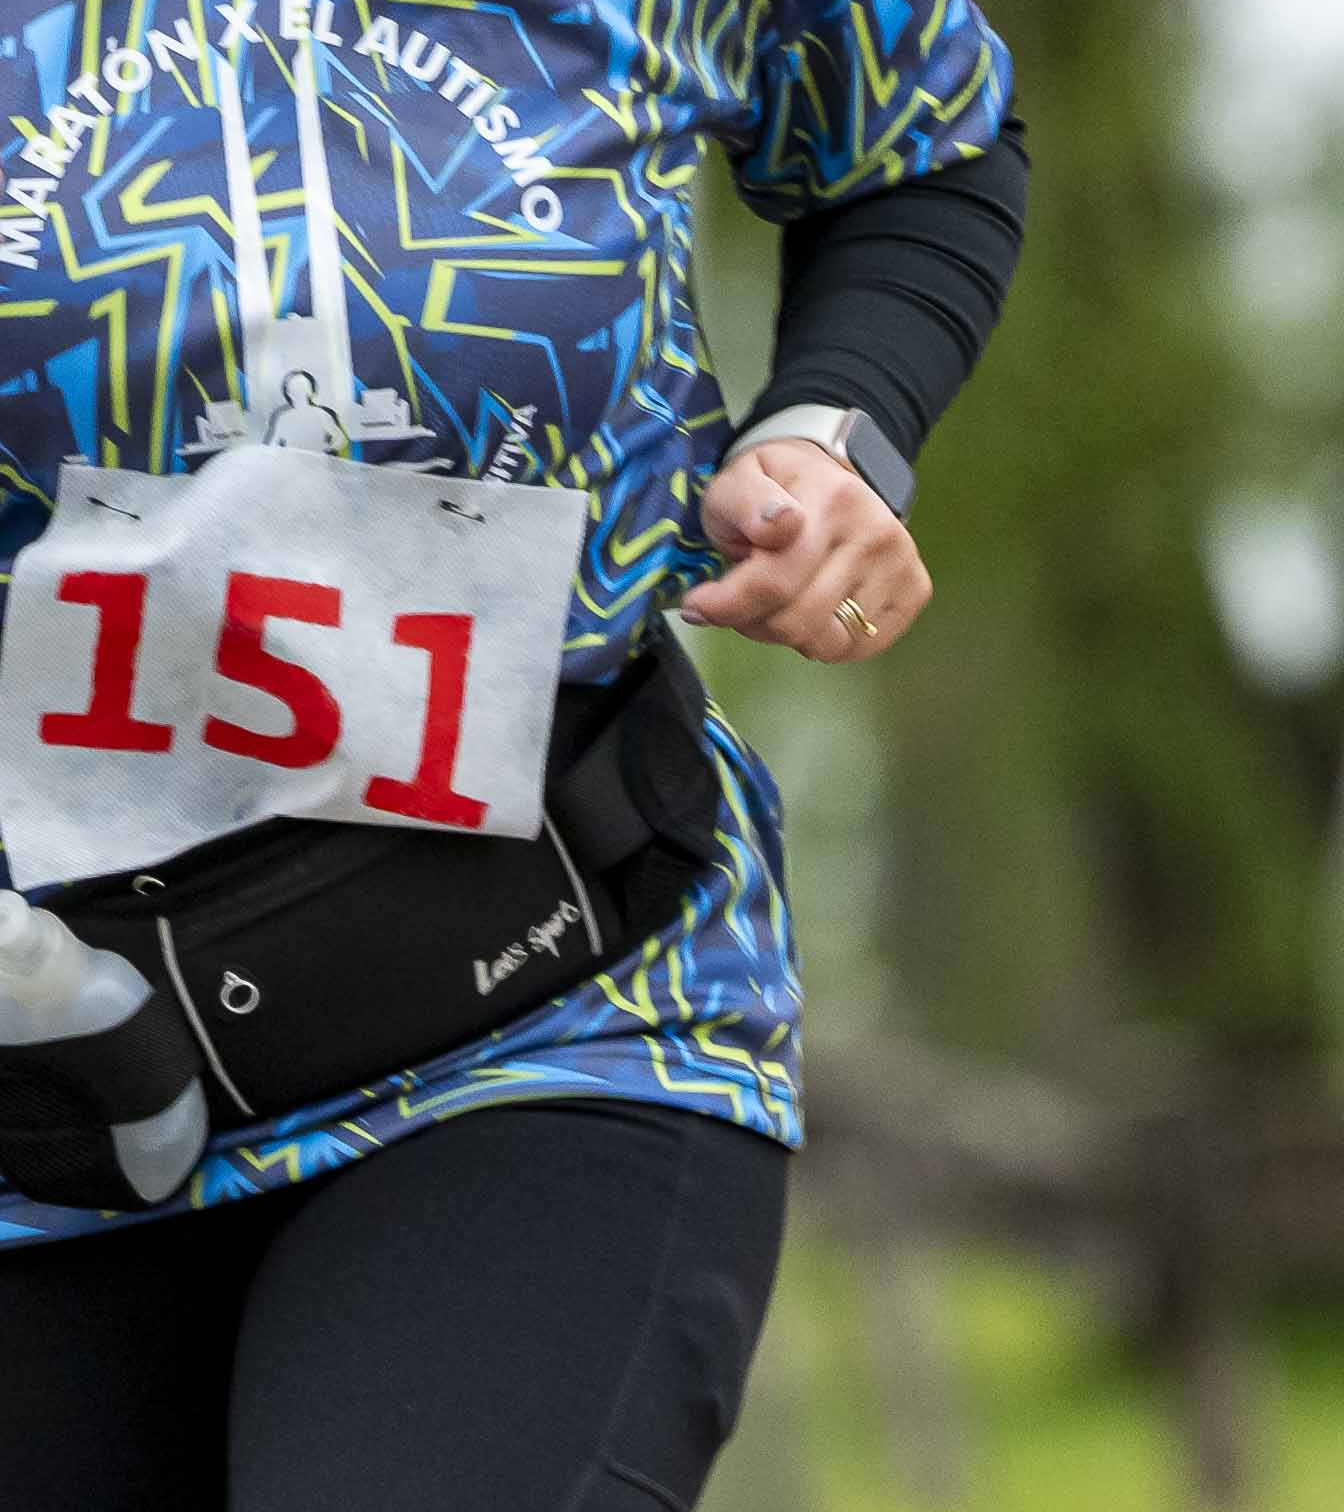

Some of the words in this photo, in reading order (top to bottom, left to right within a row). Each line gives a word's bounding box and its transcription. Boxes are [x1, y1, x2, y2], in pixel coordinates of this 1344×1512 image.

[214, 0, 264, 49] X
[352, 14, 564, 232] AUTISMO
[37, 569, 490, 830] 151
